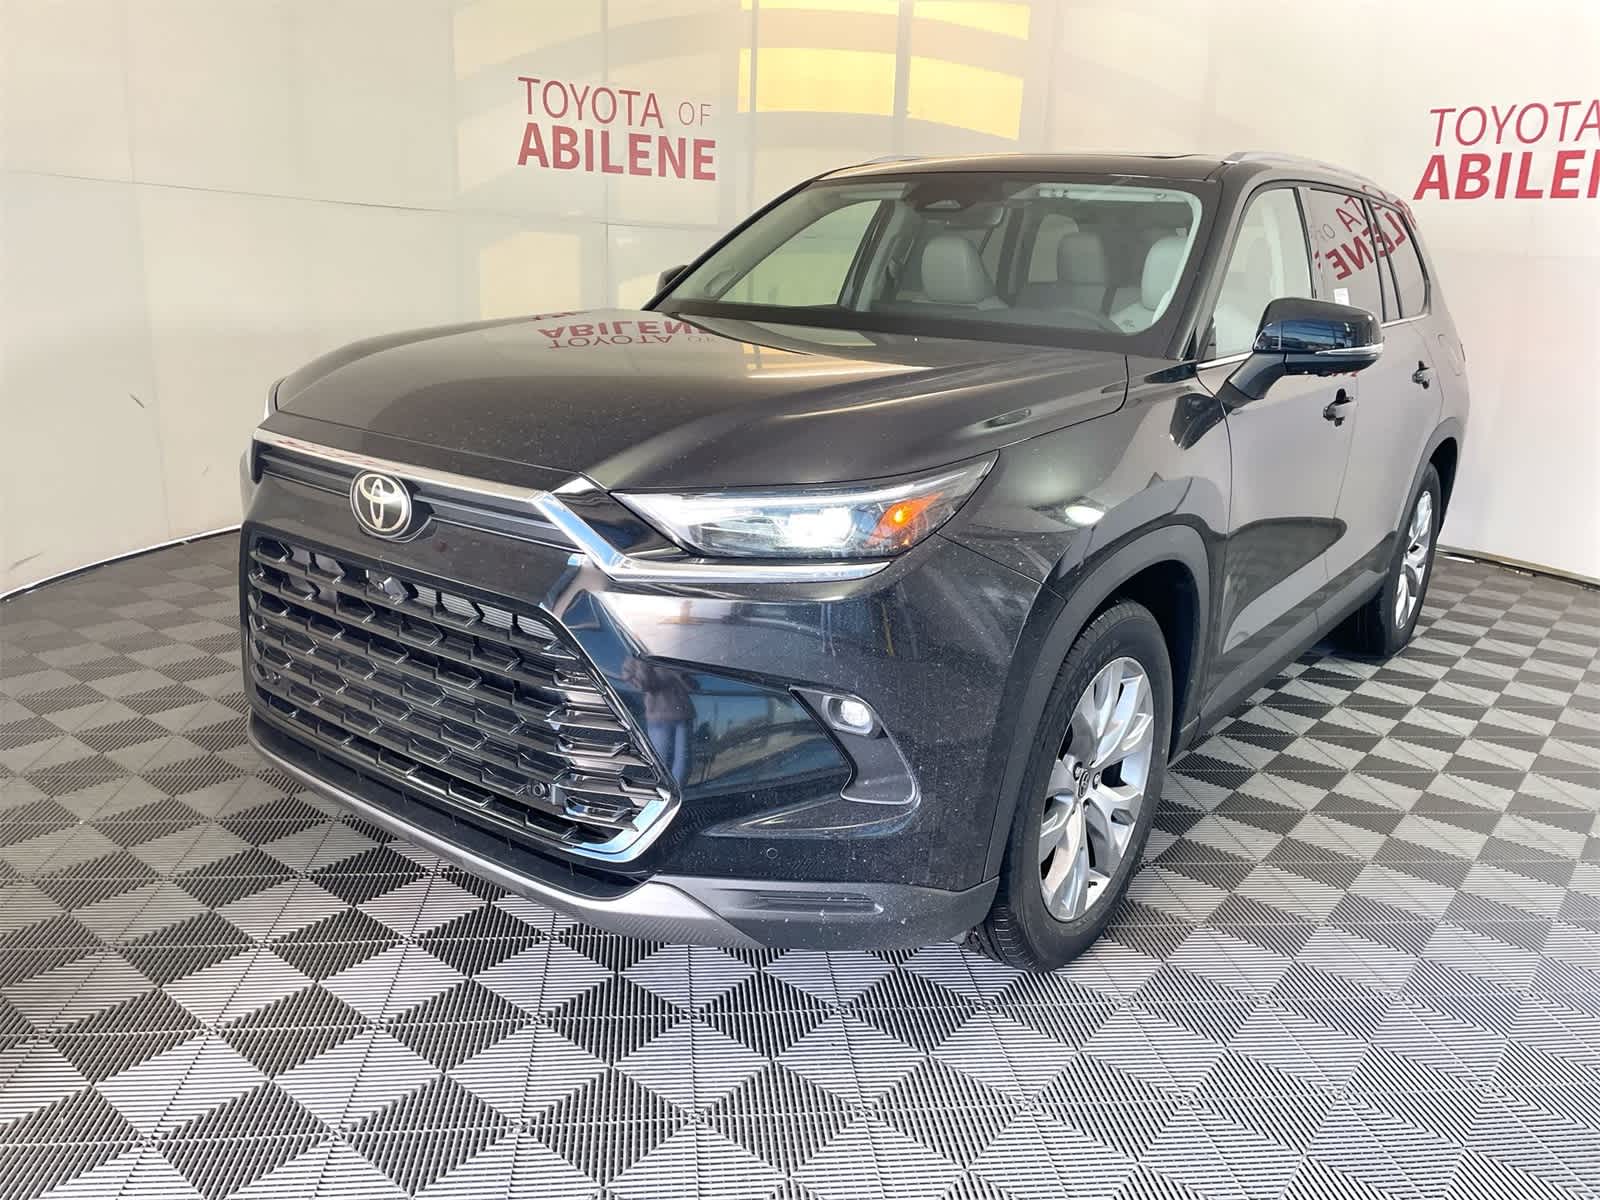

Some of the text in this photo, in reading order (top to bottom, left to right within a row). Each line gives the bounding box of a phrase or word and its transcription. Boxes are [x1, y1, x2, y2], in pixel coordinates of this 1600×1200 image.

[518, 76, 713, 129] TOYOTA OF
[1430, 99, 1600, 147] TOYOTA
[517, 122, 716, 181] ABILENE
